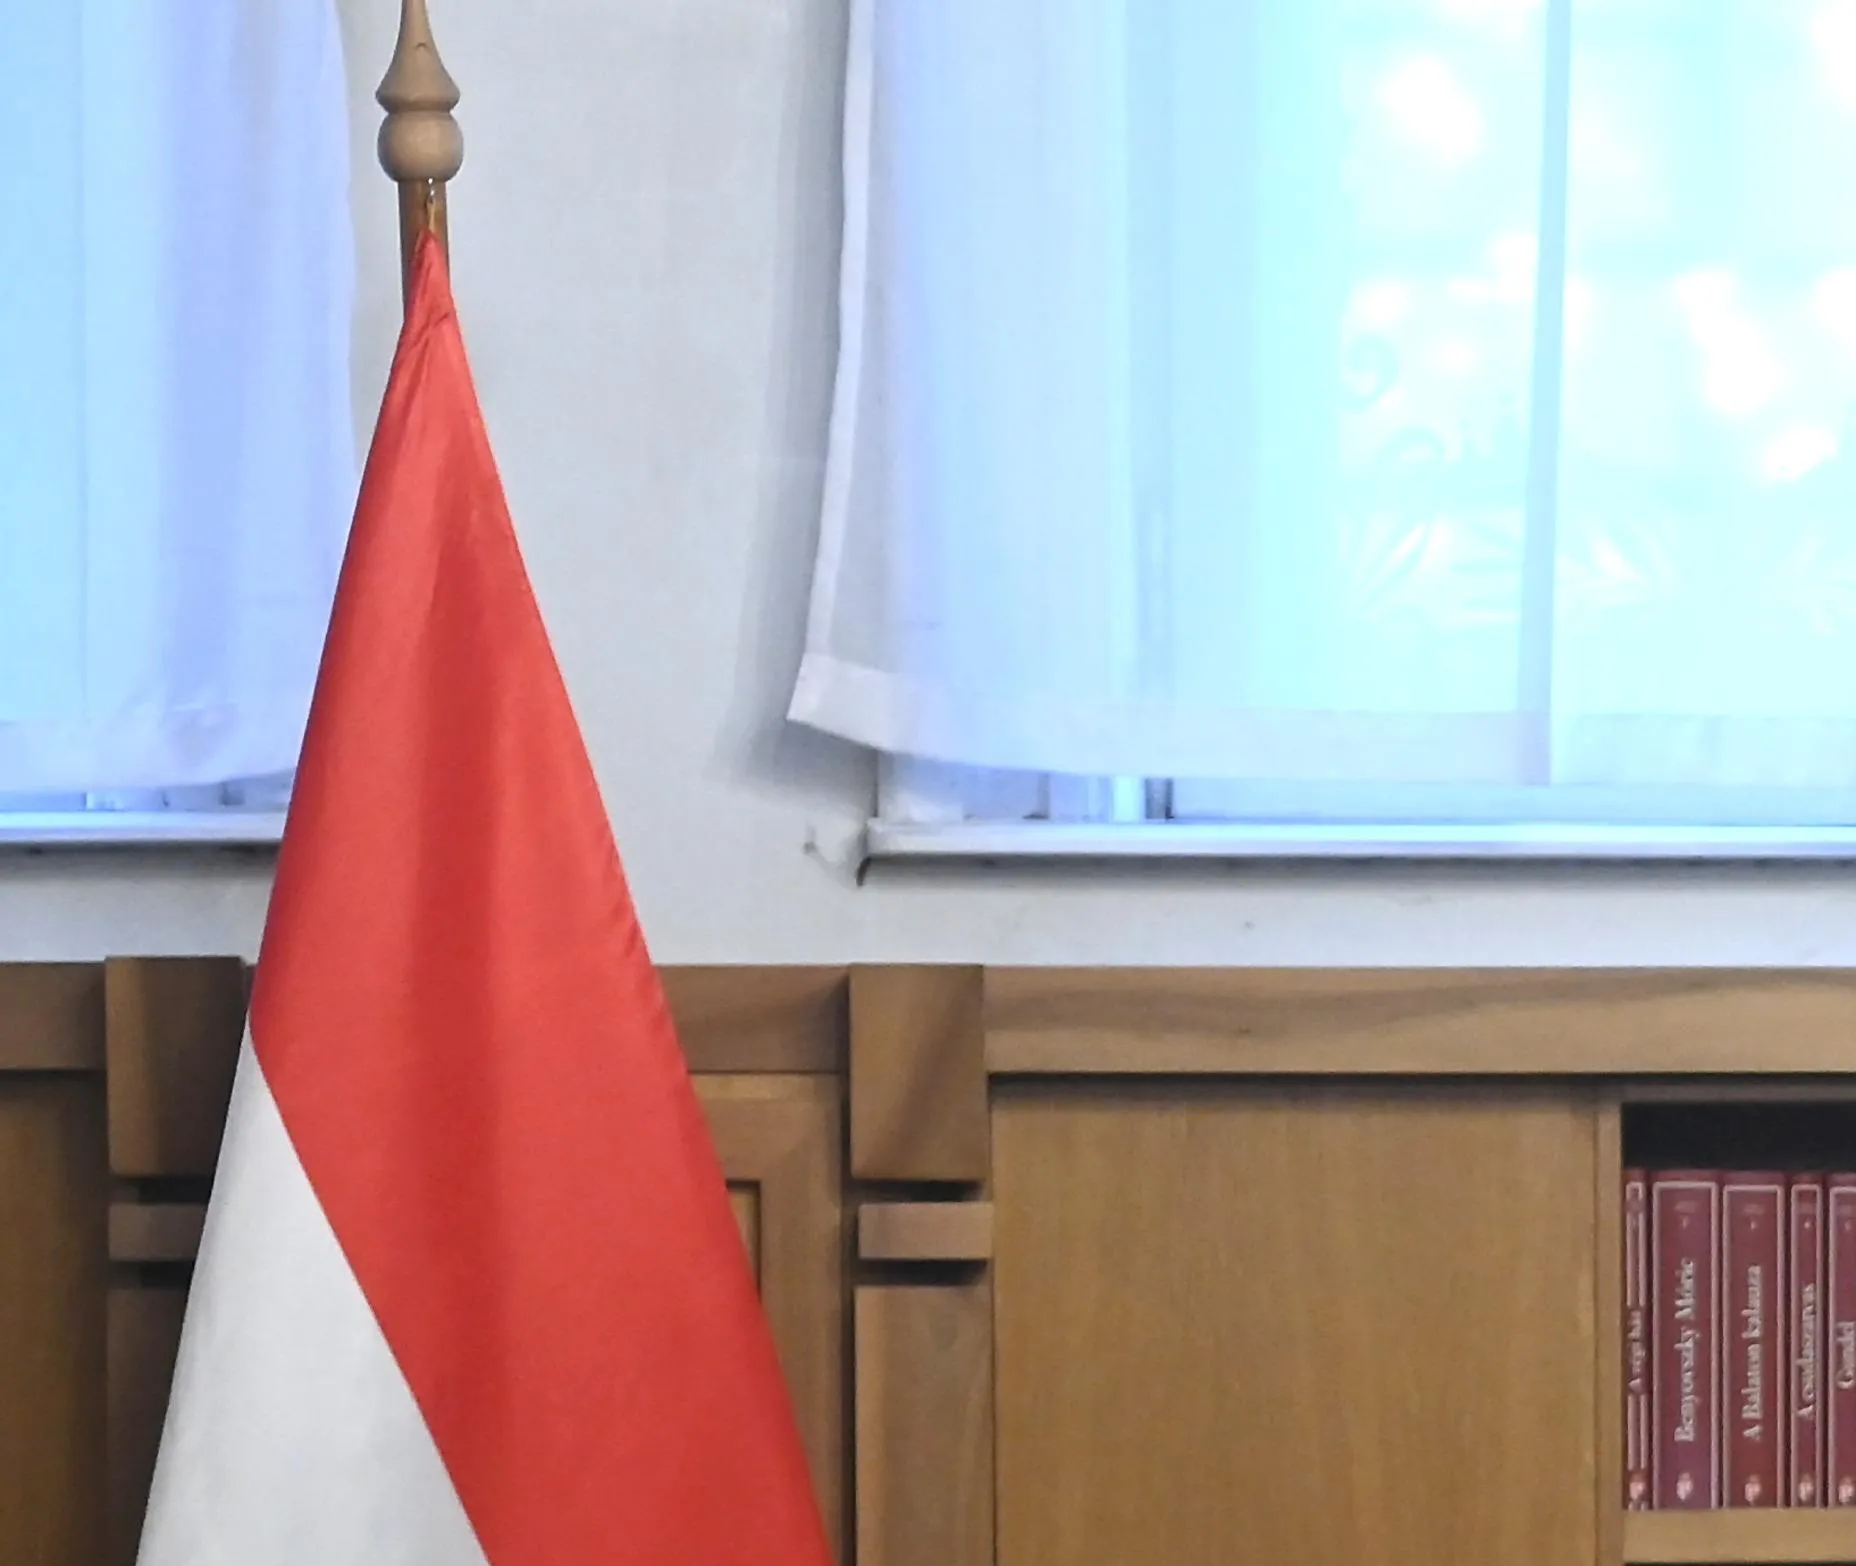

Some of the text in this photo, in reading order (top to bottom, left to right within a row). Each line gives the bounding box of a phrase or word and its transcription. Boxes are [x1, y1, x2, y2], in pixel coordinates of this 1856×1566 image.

[1675, 1258, 1695, 1320] Móric
[1741, 1265, 1762, 1440] A Balaton kalauza
